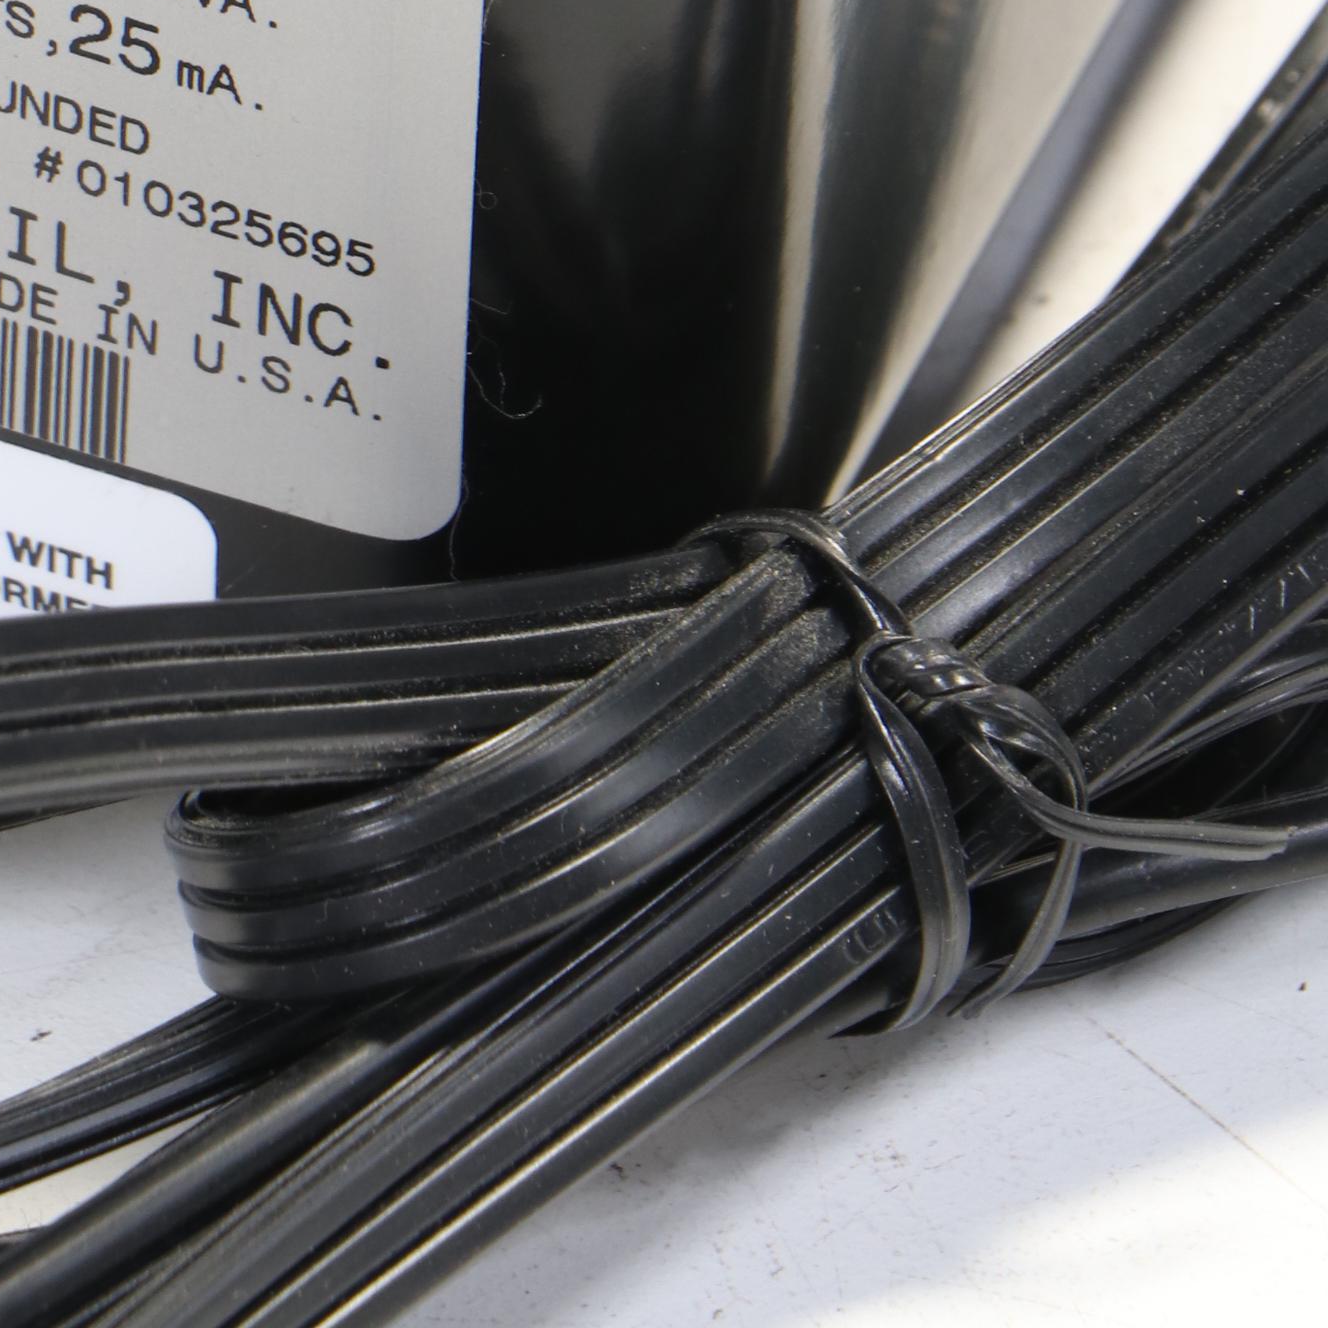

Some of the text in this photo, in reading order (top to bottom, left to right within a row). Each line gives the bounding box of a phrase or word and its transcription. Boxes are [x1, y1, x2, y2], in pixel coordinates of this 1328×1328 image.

[97, 303, 158, 356] IN
[194, 333, 382, 421] U.S.A.
[211, 270, 390, 370] INC.
[6, 531, 112, 590] WITH
